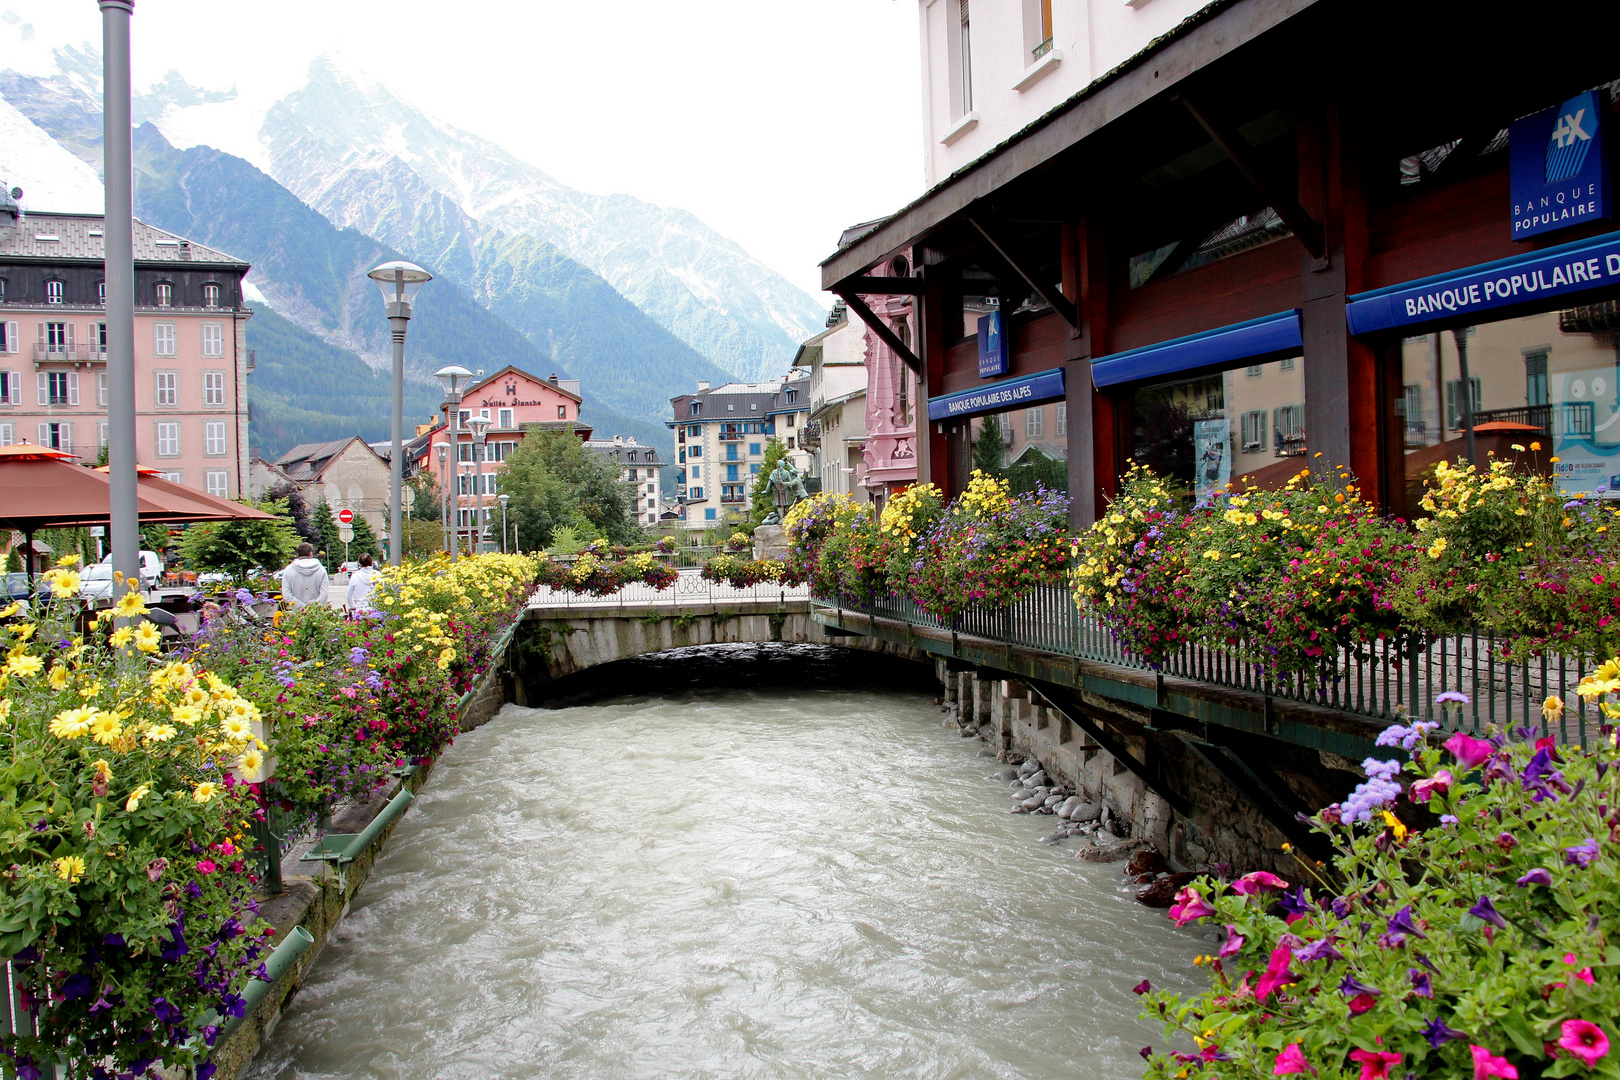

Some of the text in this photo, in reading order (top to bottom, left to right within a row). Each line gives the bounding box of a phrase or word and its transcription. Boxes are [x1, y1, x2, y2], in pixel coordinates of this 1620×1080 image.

[1514, 184, 1595, 215] BANQUE
[1515, 201, 1595, 231] POPULAIRE
[1405, 284, 1481, 316] BANQUE
[1484, 258, 1601, 300] POPULAIRE
[979, 363, 1000, 374] POPULAIRE
[511, 398, 541, 406] Blanche
[948, 385, 1032, 412] BANQUE POPULAIRE DES ALPES
